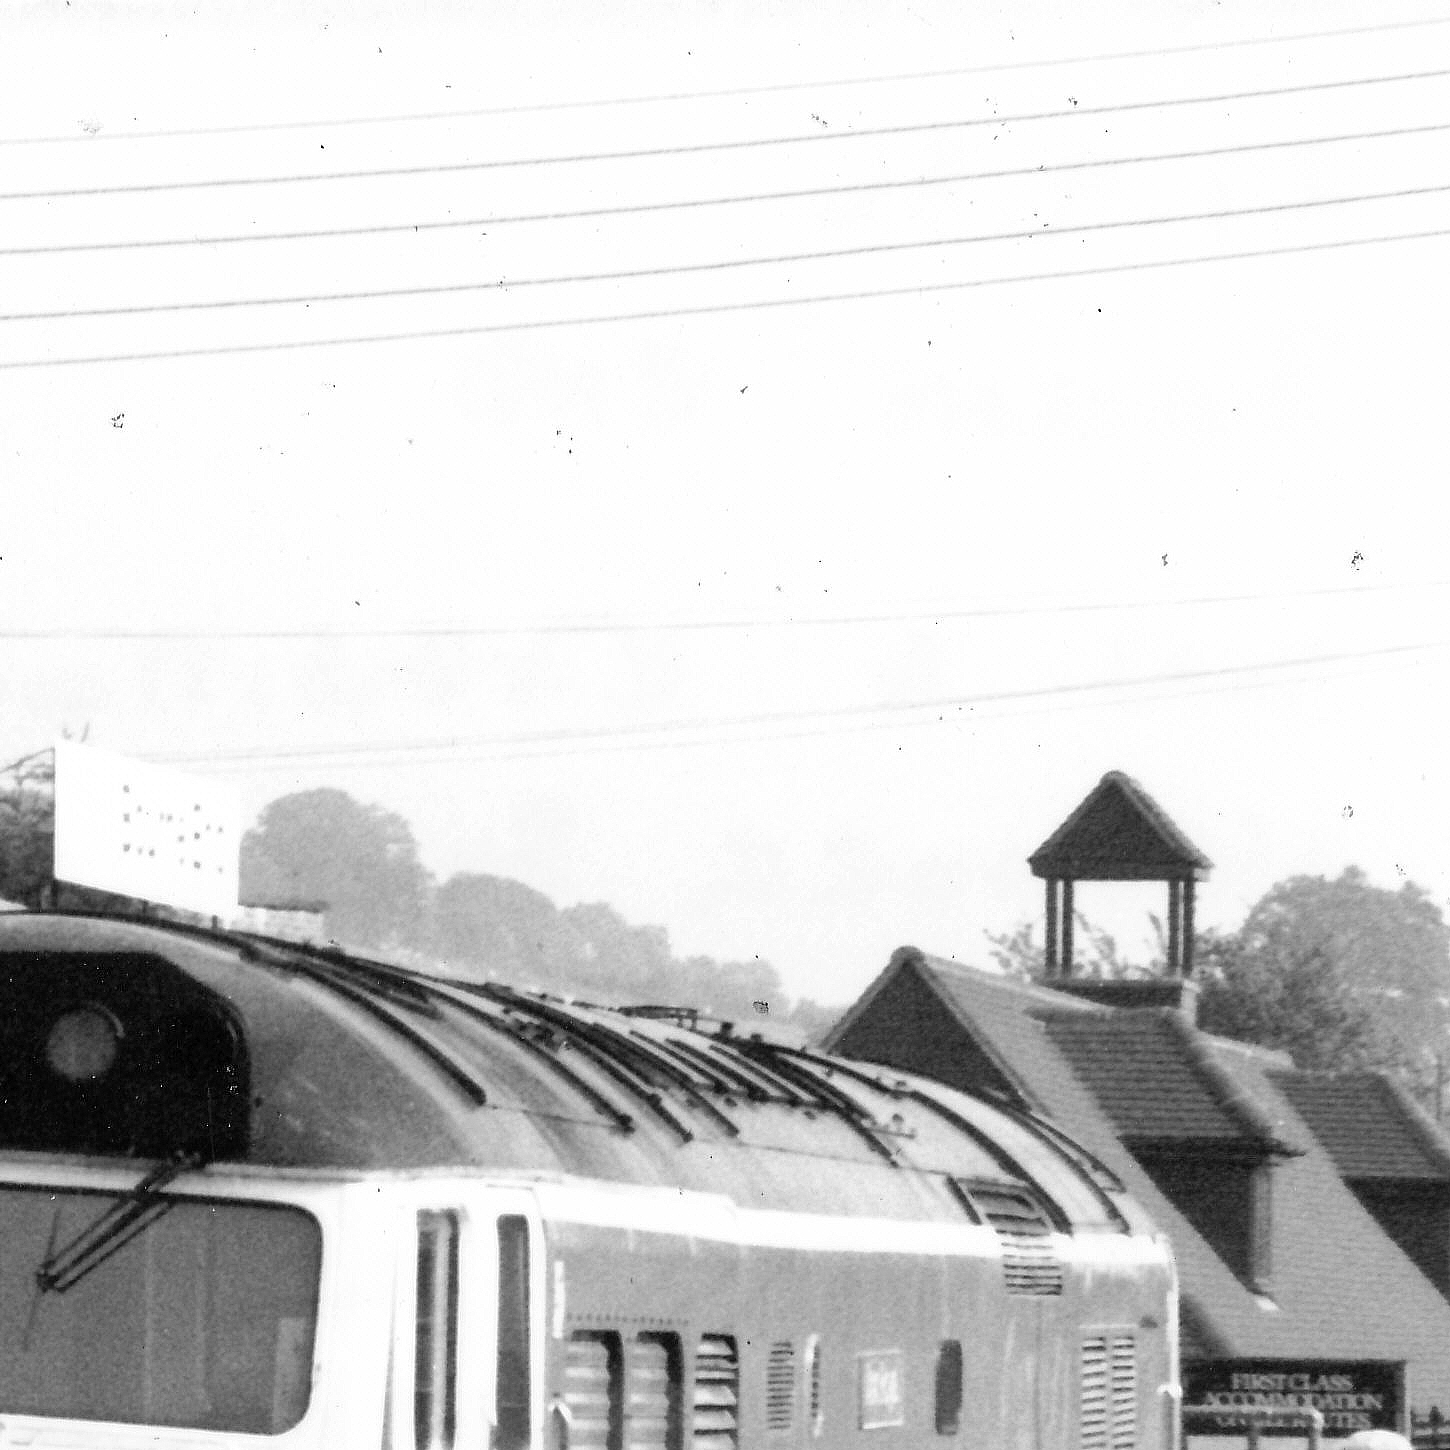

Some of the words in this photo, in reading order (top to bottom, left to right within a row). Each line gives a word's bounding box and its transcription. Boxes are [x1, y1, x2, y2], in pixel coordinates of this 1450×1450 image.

[1231, 1373, 1287, 1391] FIRST
[1288, 1373, 1354, 1391] CLASS
[1202, 1391, 1384, 1411] ACCOMMODATION
